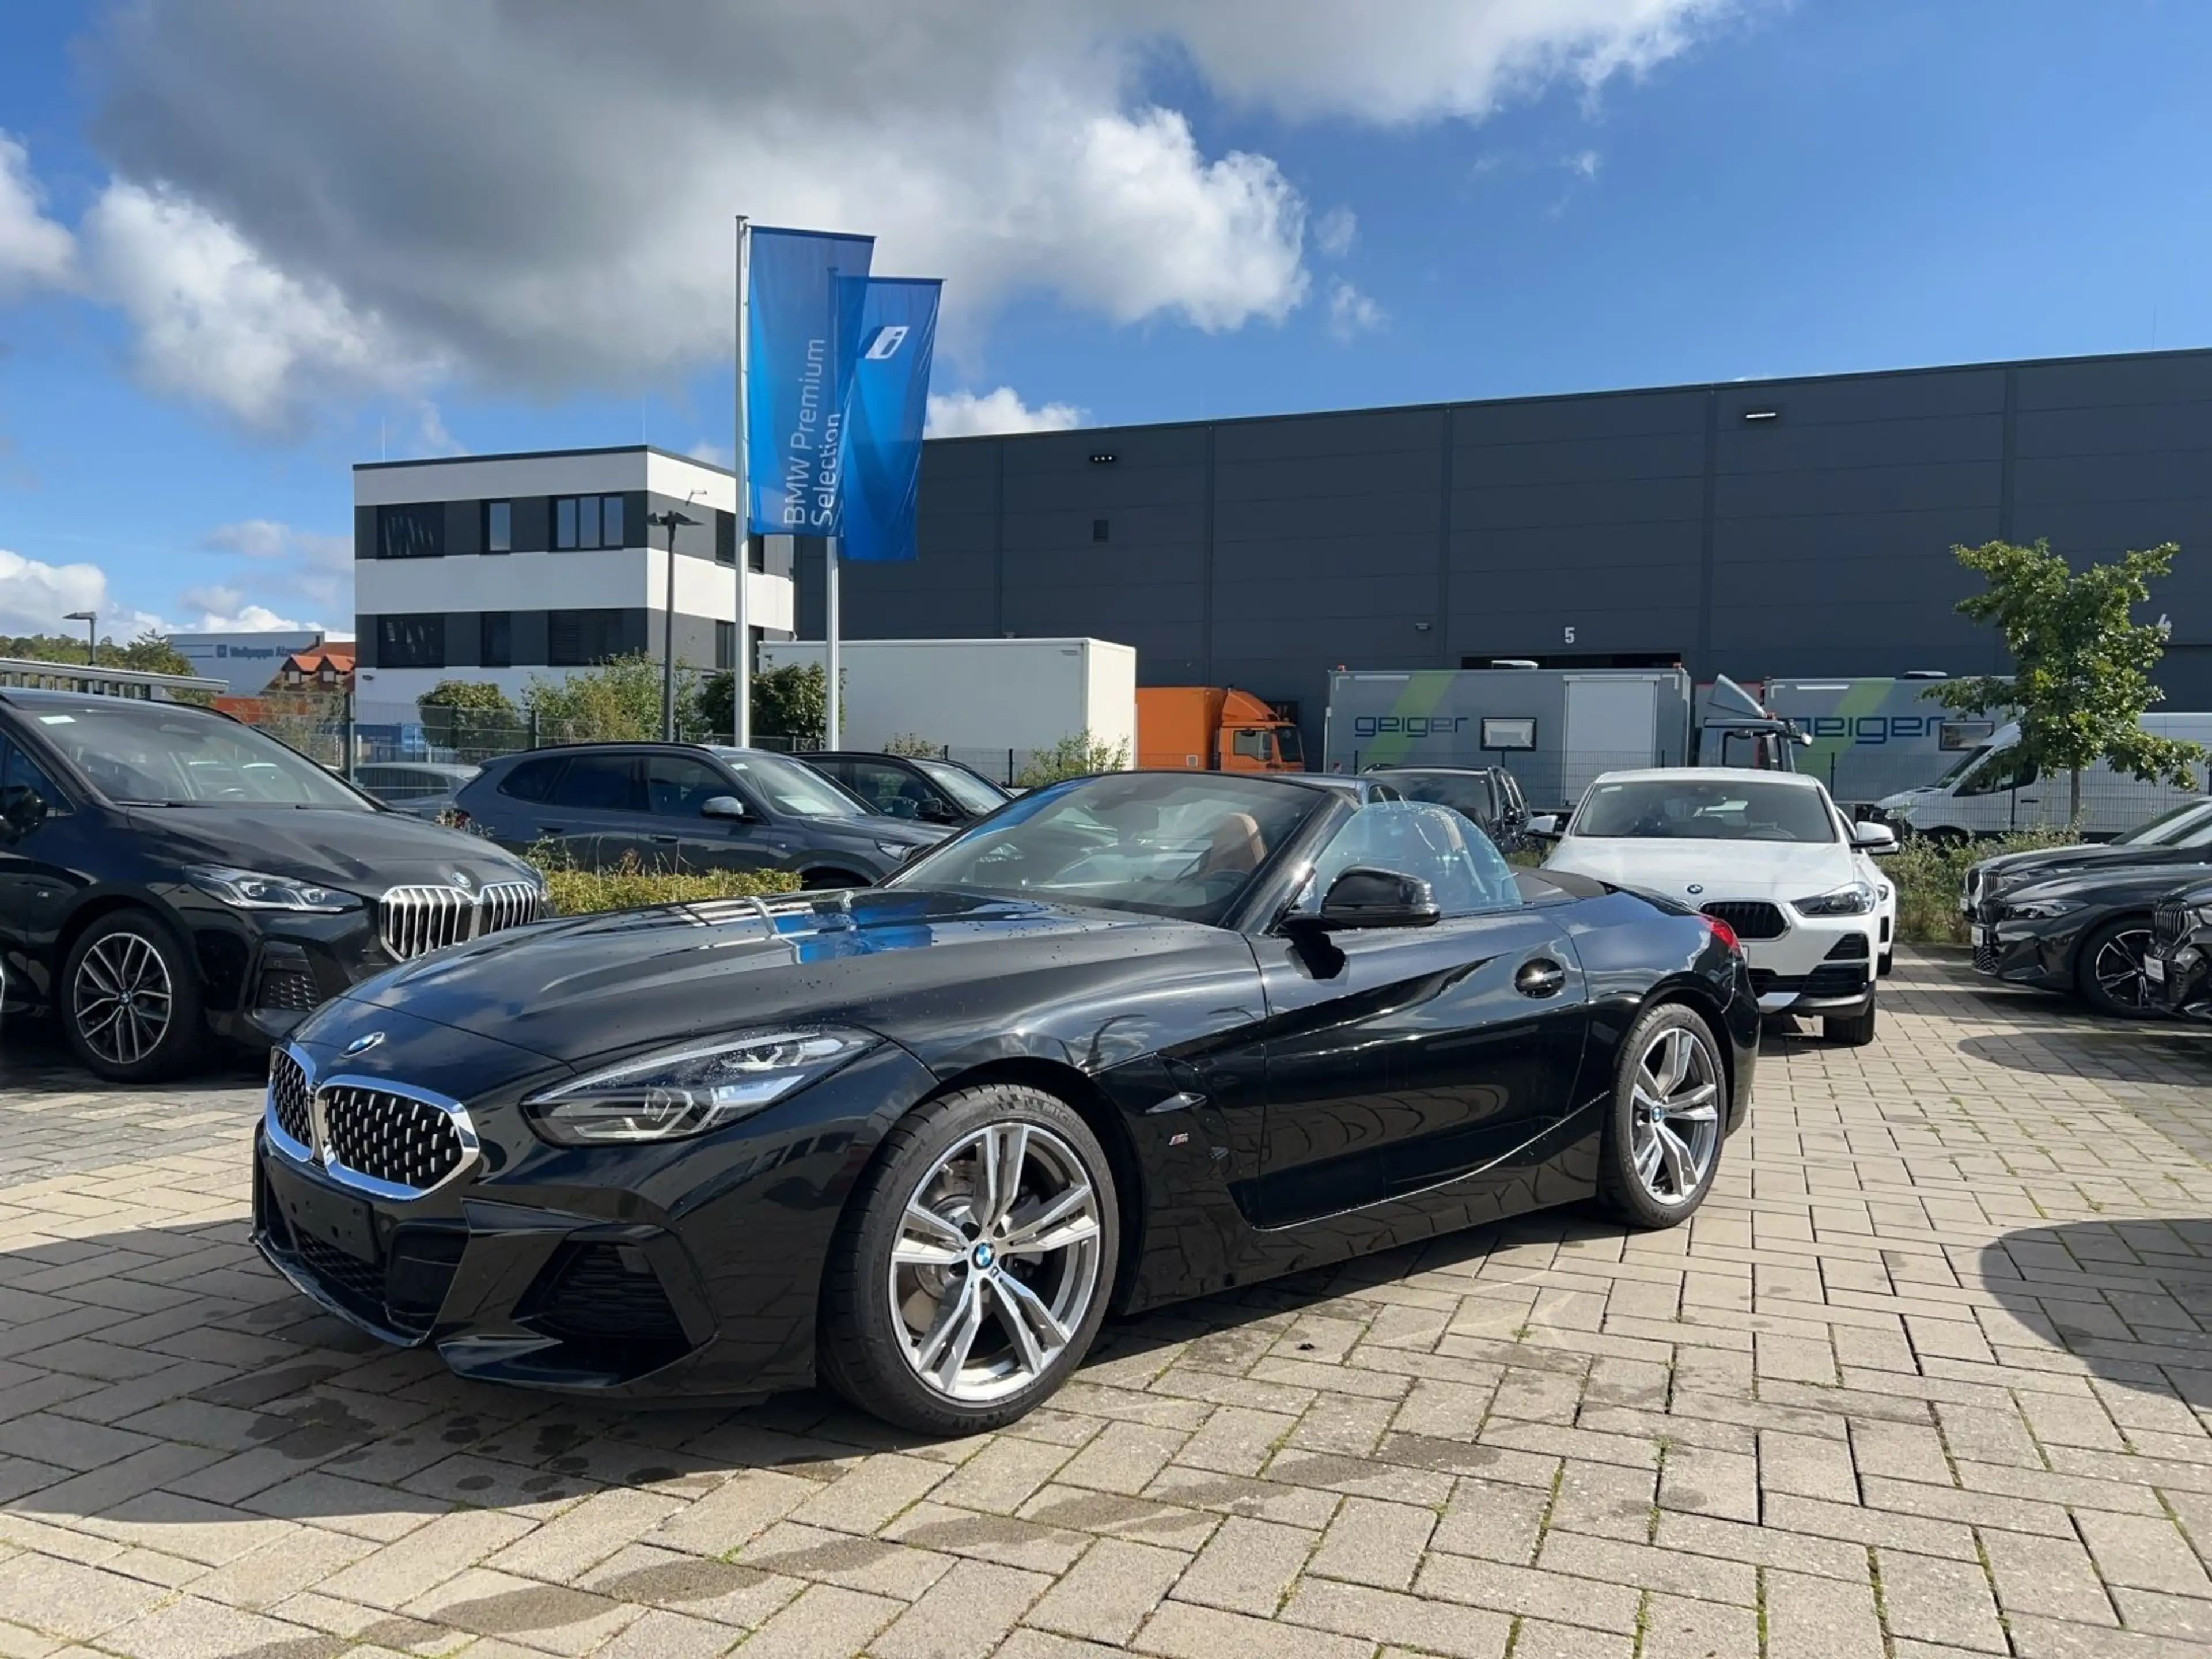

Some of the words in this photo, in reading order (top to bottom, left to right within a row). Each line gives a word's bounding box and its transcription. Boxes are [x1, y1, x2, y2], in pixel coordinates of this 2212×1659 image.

[791, 339, 825, 449] Premium
[784, 457, 810, 524] BMW
[811, 412, 841, 527] Selection
[1565, 626, 1575, 644] 5
[1355, 717, 1469, 737] geiger
